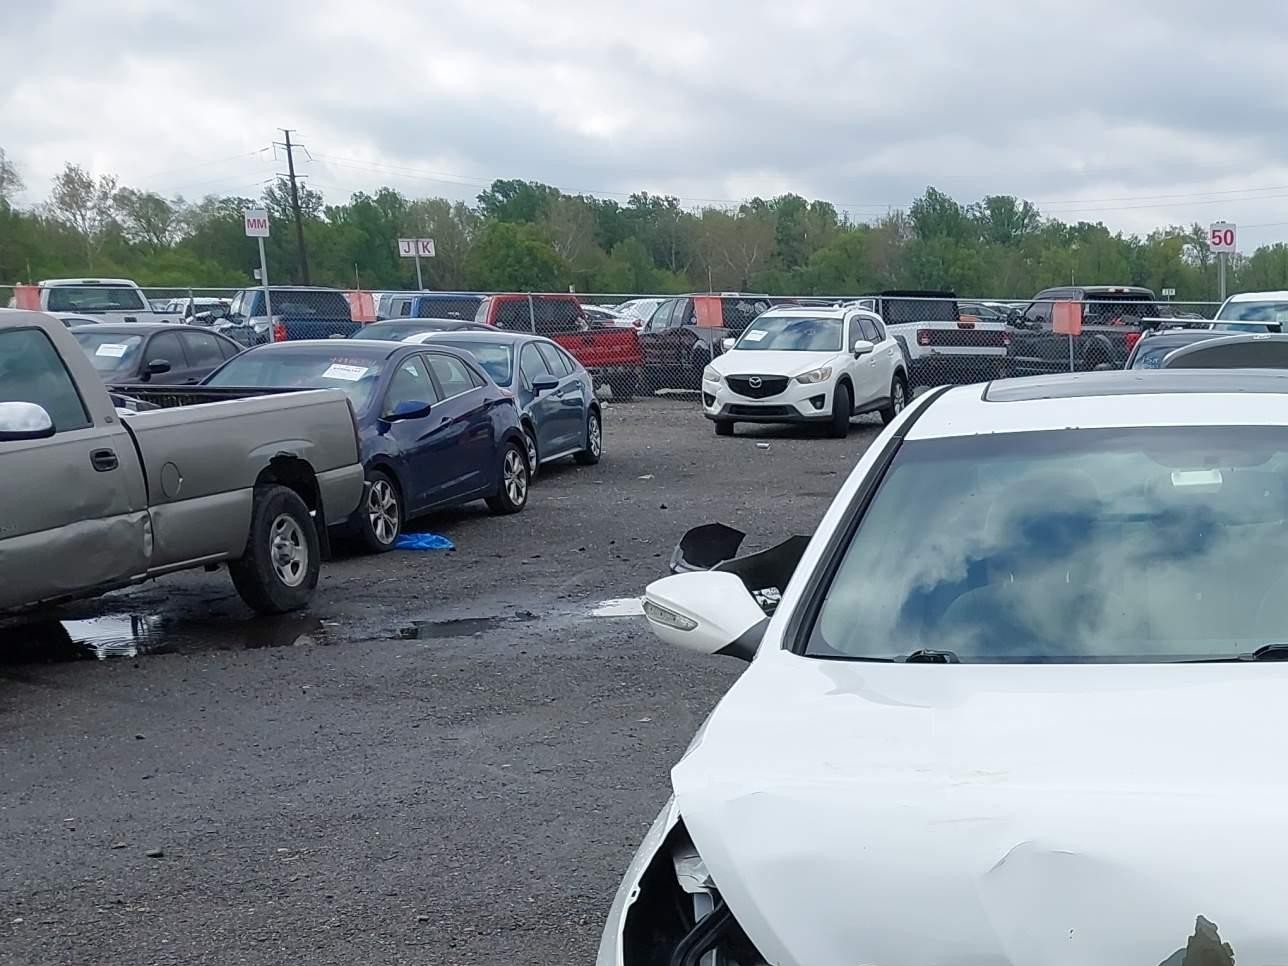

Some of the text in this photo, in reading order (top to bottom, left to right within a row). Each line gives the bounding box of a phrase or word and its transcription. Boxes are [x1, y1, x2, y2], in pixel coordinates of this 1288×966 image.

[247, 218, 267, 229] MM
[1211, 229, 1234, 246] 50
[403, 241, 432, 254] J K
